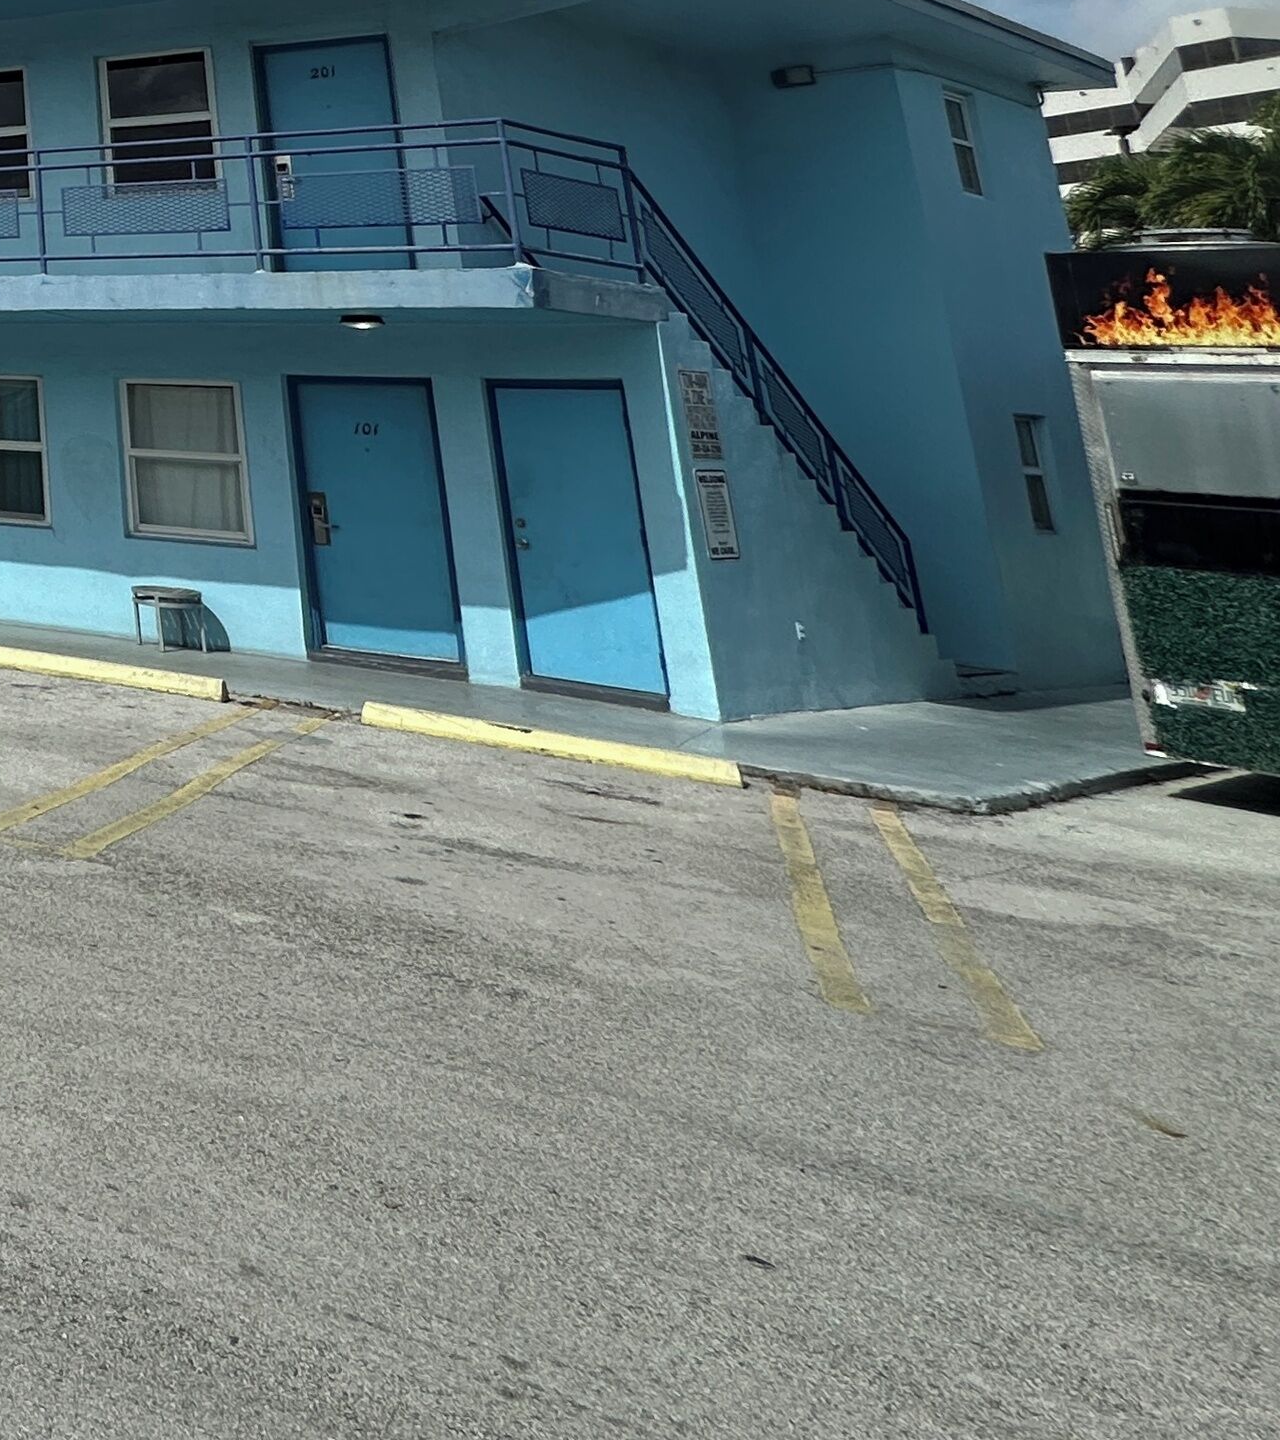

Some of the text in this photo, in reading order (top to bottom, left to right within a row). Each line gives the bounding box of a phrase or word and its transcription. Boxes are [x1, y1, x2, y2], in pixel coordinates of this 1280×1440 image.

[310, 65, 336, 80] 201
[354, 422, 379, 436] 101
[690, 430, 720, 441] ALPINE
